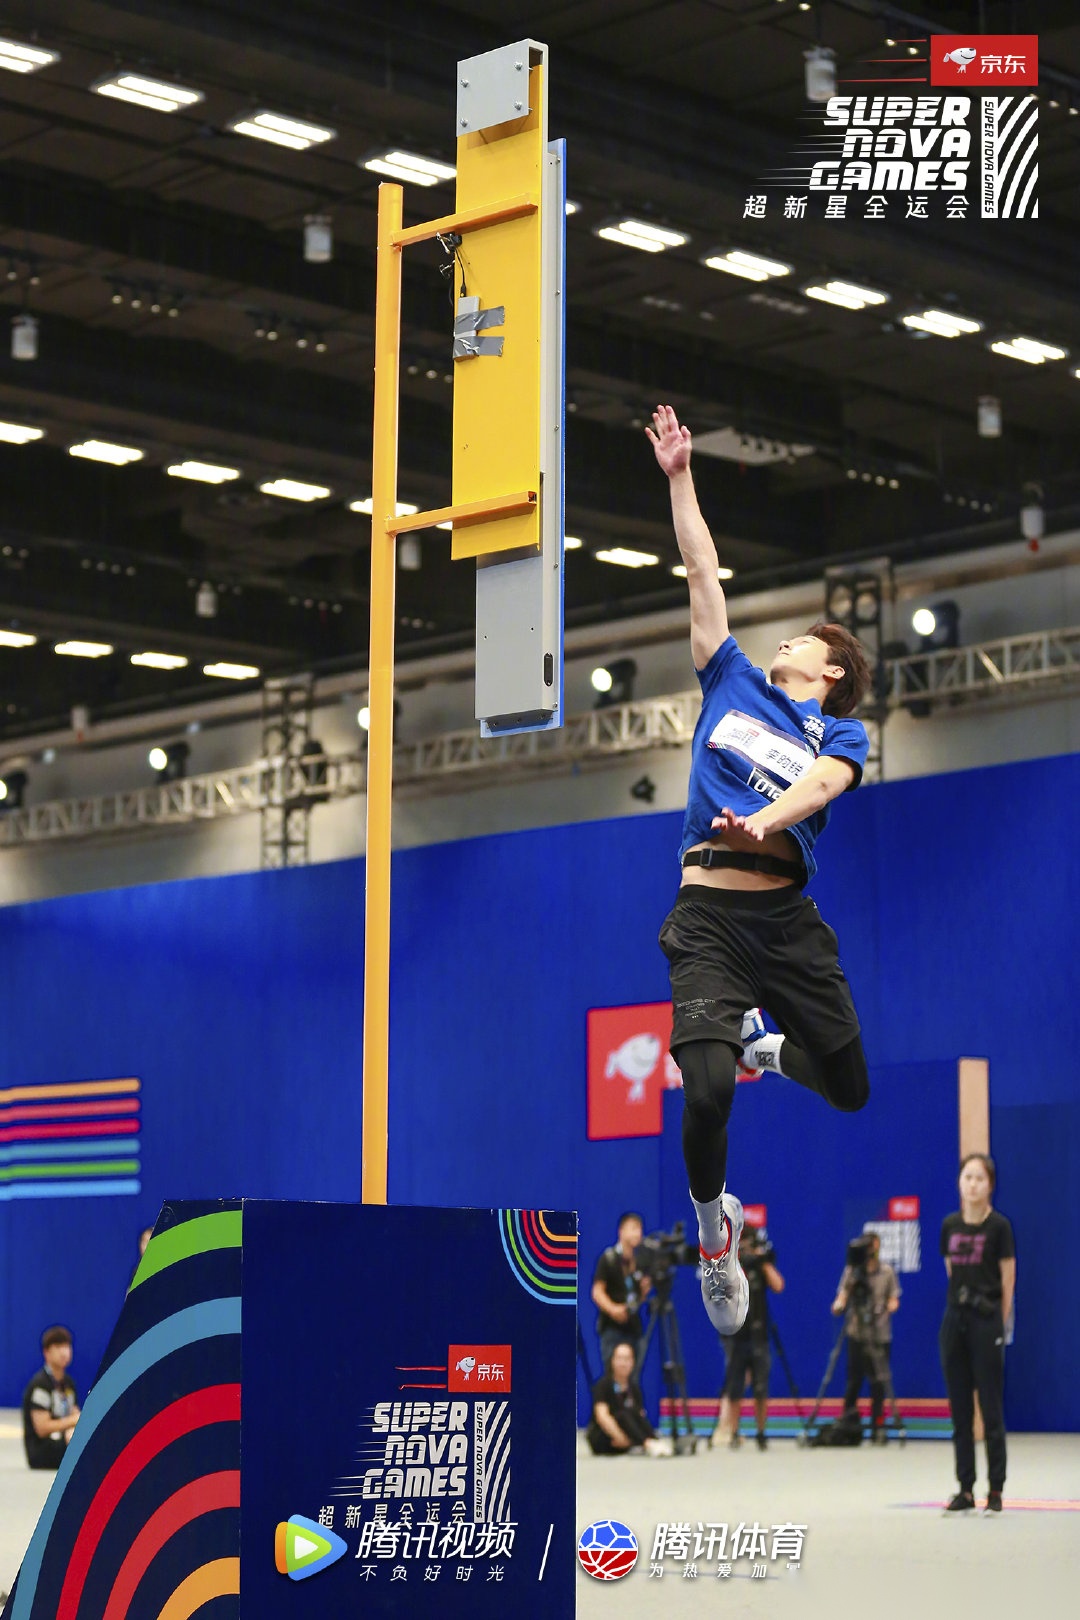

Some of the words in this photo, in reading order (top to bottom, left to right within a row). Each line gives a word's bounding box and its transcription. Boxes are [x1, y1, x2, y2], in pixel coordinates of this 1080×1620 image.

[477, 1363, 504, 1381] 京东
[372, 1401, 468, 1433] SUPER
[384, 1434, 468, 1466] NOVA
[362, 1466, 468, 1499] GAMES
[475, 1479, 483, 1518] GAMES
